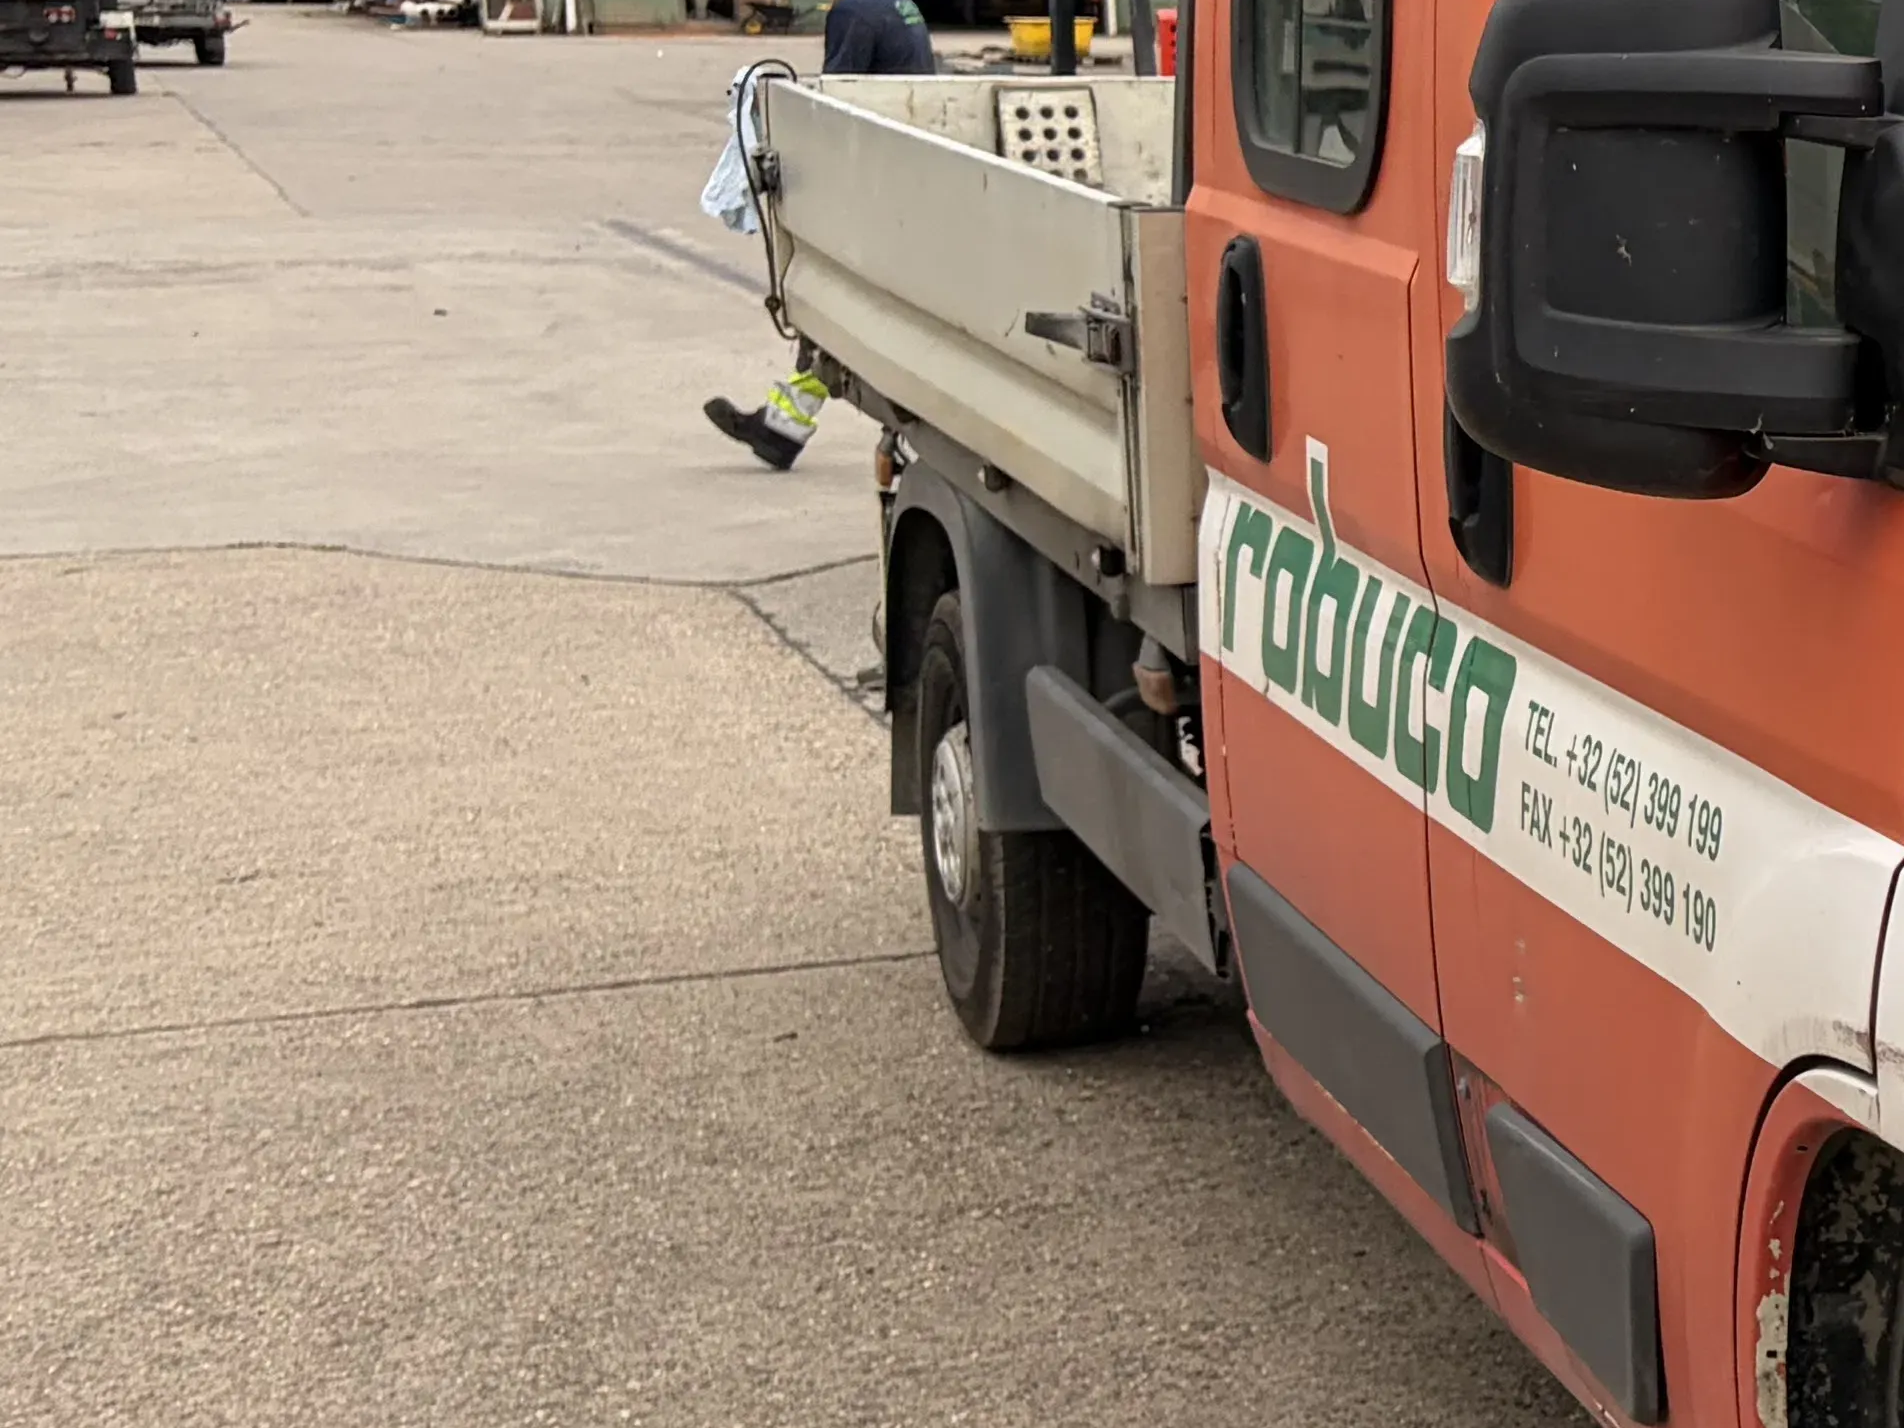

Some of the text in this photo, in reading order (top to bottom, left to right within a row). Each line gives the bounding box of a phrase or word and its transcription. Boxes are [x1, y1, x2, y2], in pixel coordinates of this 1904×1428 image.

[1222, 456, 1518, 835] robuco
[1520, 780, 1717, 954] FAX +32 (52) 399 190
[1525, 699, 1558, 769] TEL.
[1566, 733, 1603, 793] +32
[1643, 771, 1682, 839] 399
[1688, 792, 1723, 863] 199
